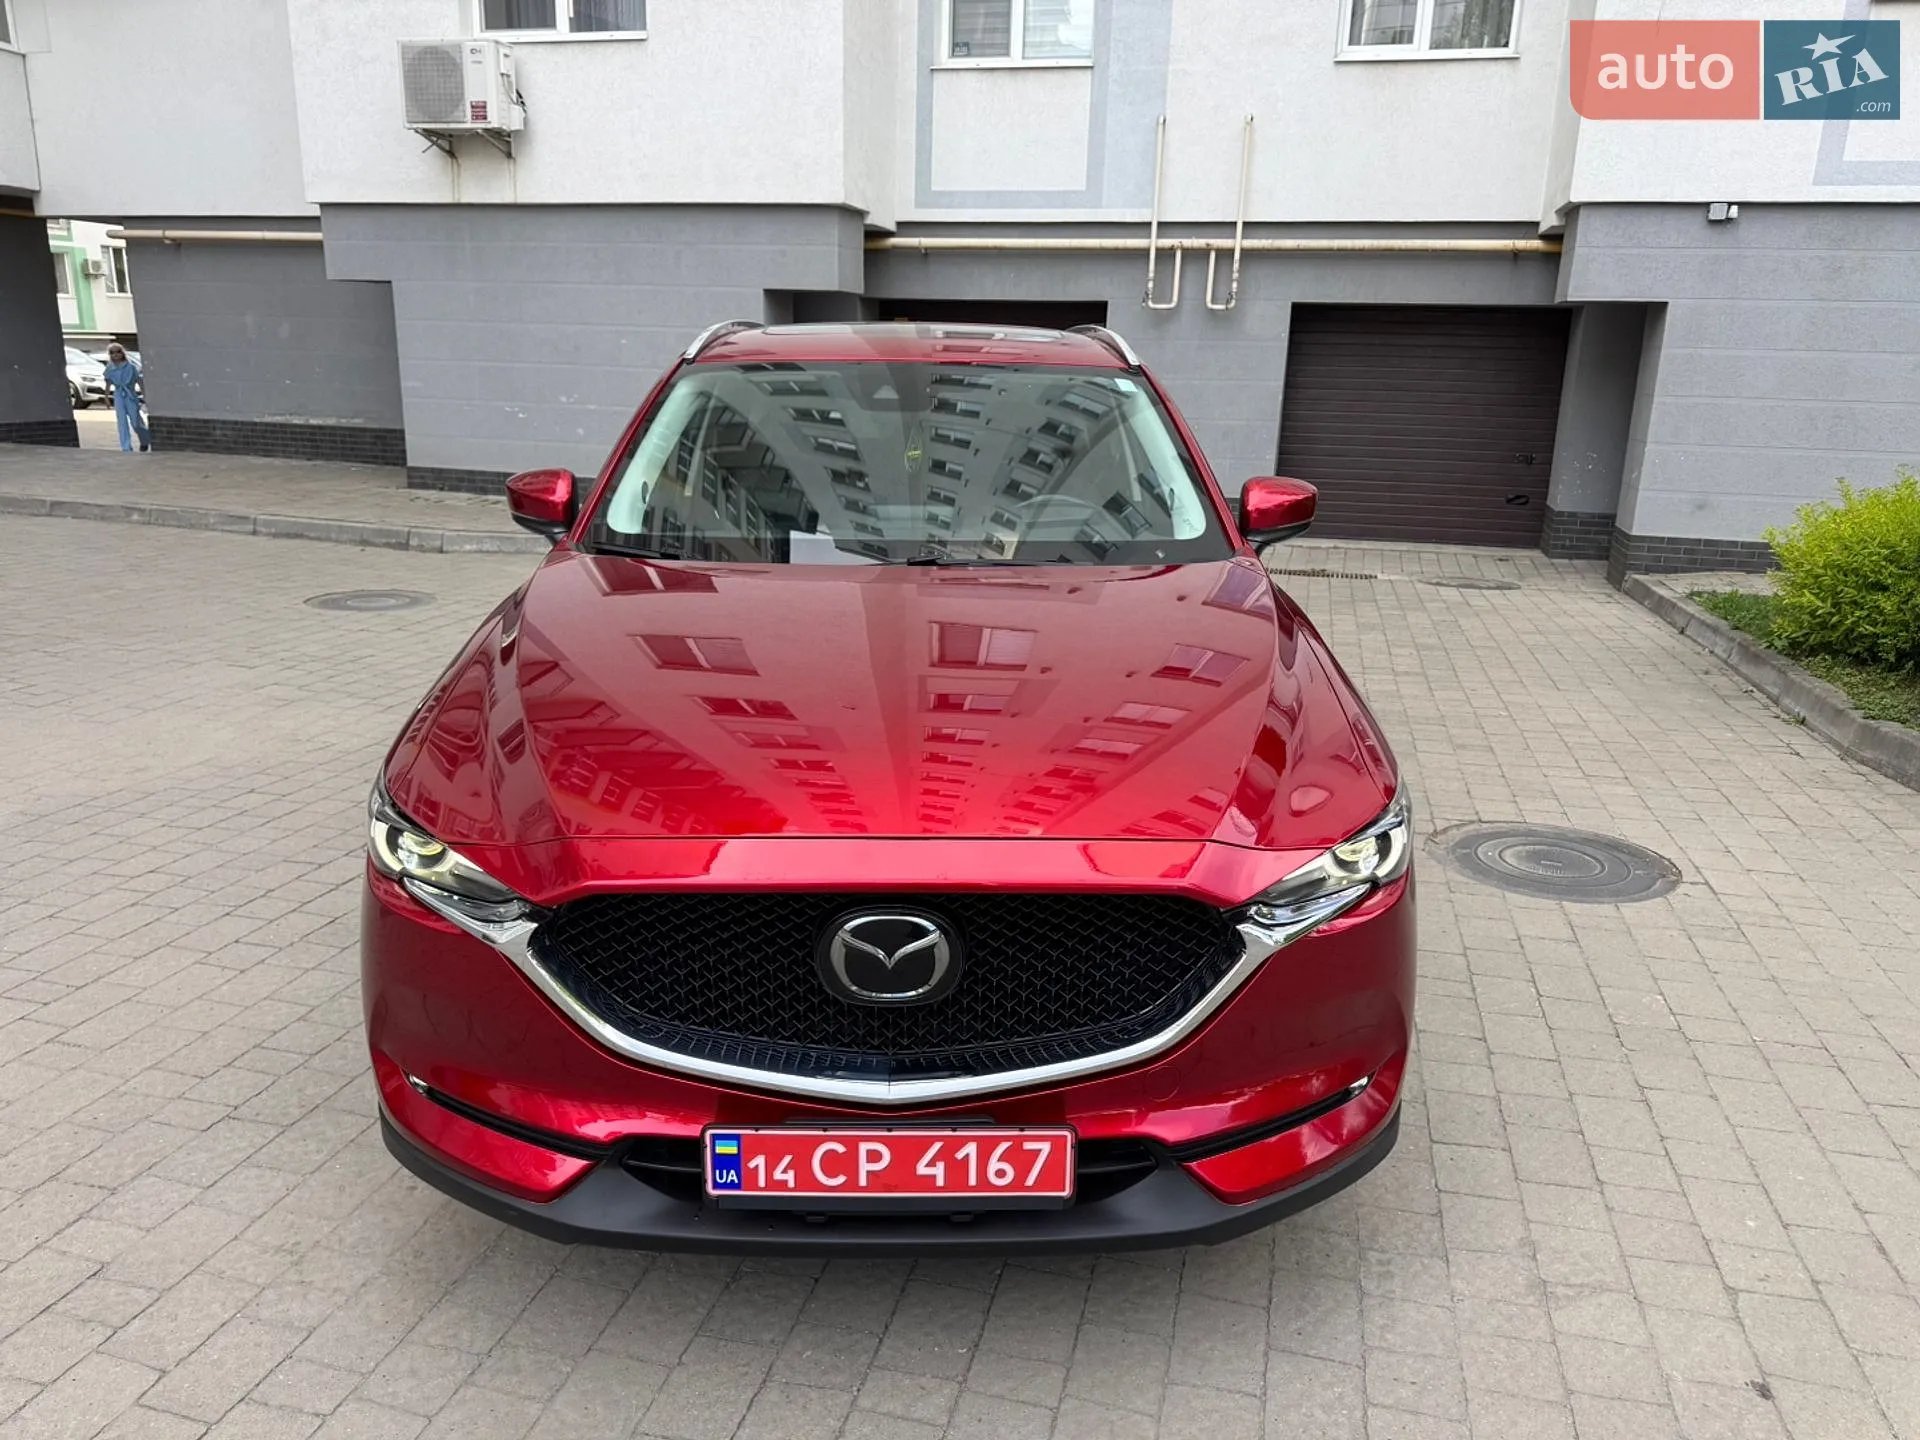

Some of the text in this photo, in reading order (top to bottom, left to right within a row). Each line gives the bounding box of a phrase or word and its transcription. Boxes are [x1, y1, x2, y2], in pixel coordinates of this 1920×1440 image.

[715, 1170, 739, 1184] UA
[747, 1141, 1052, 1187] 14 CP 4167
